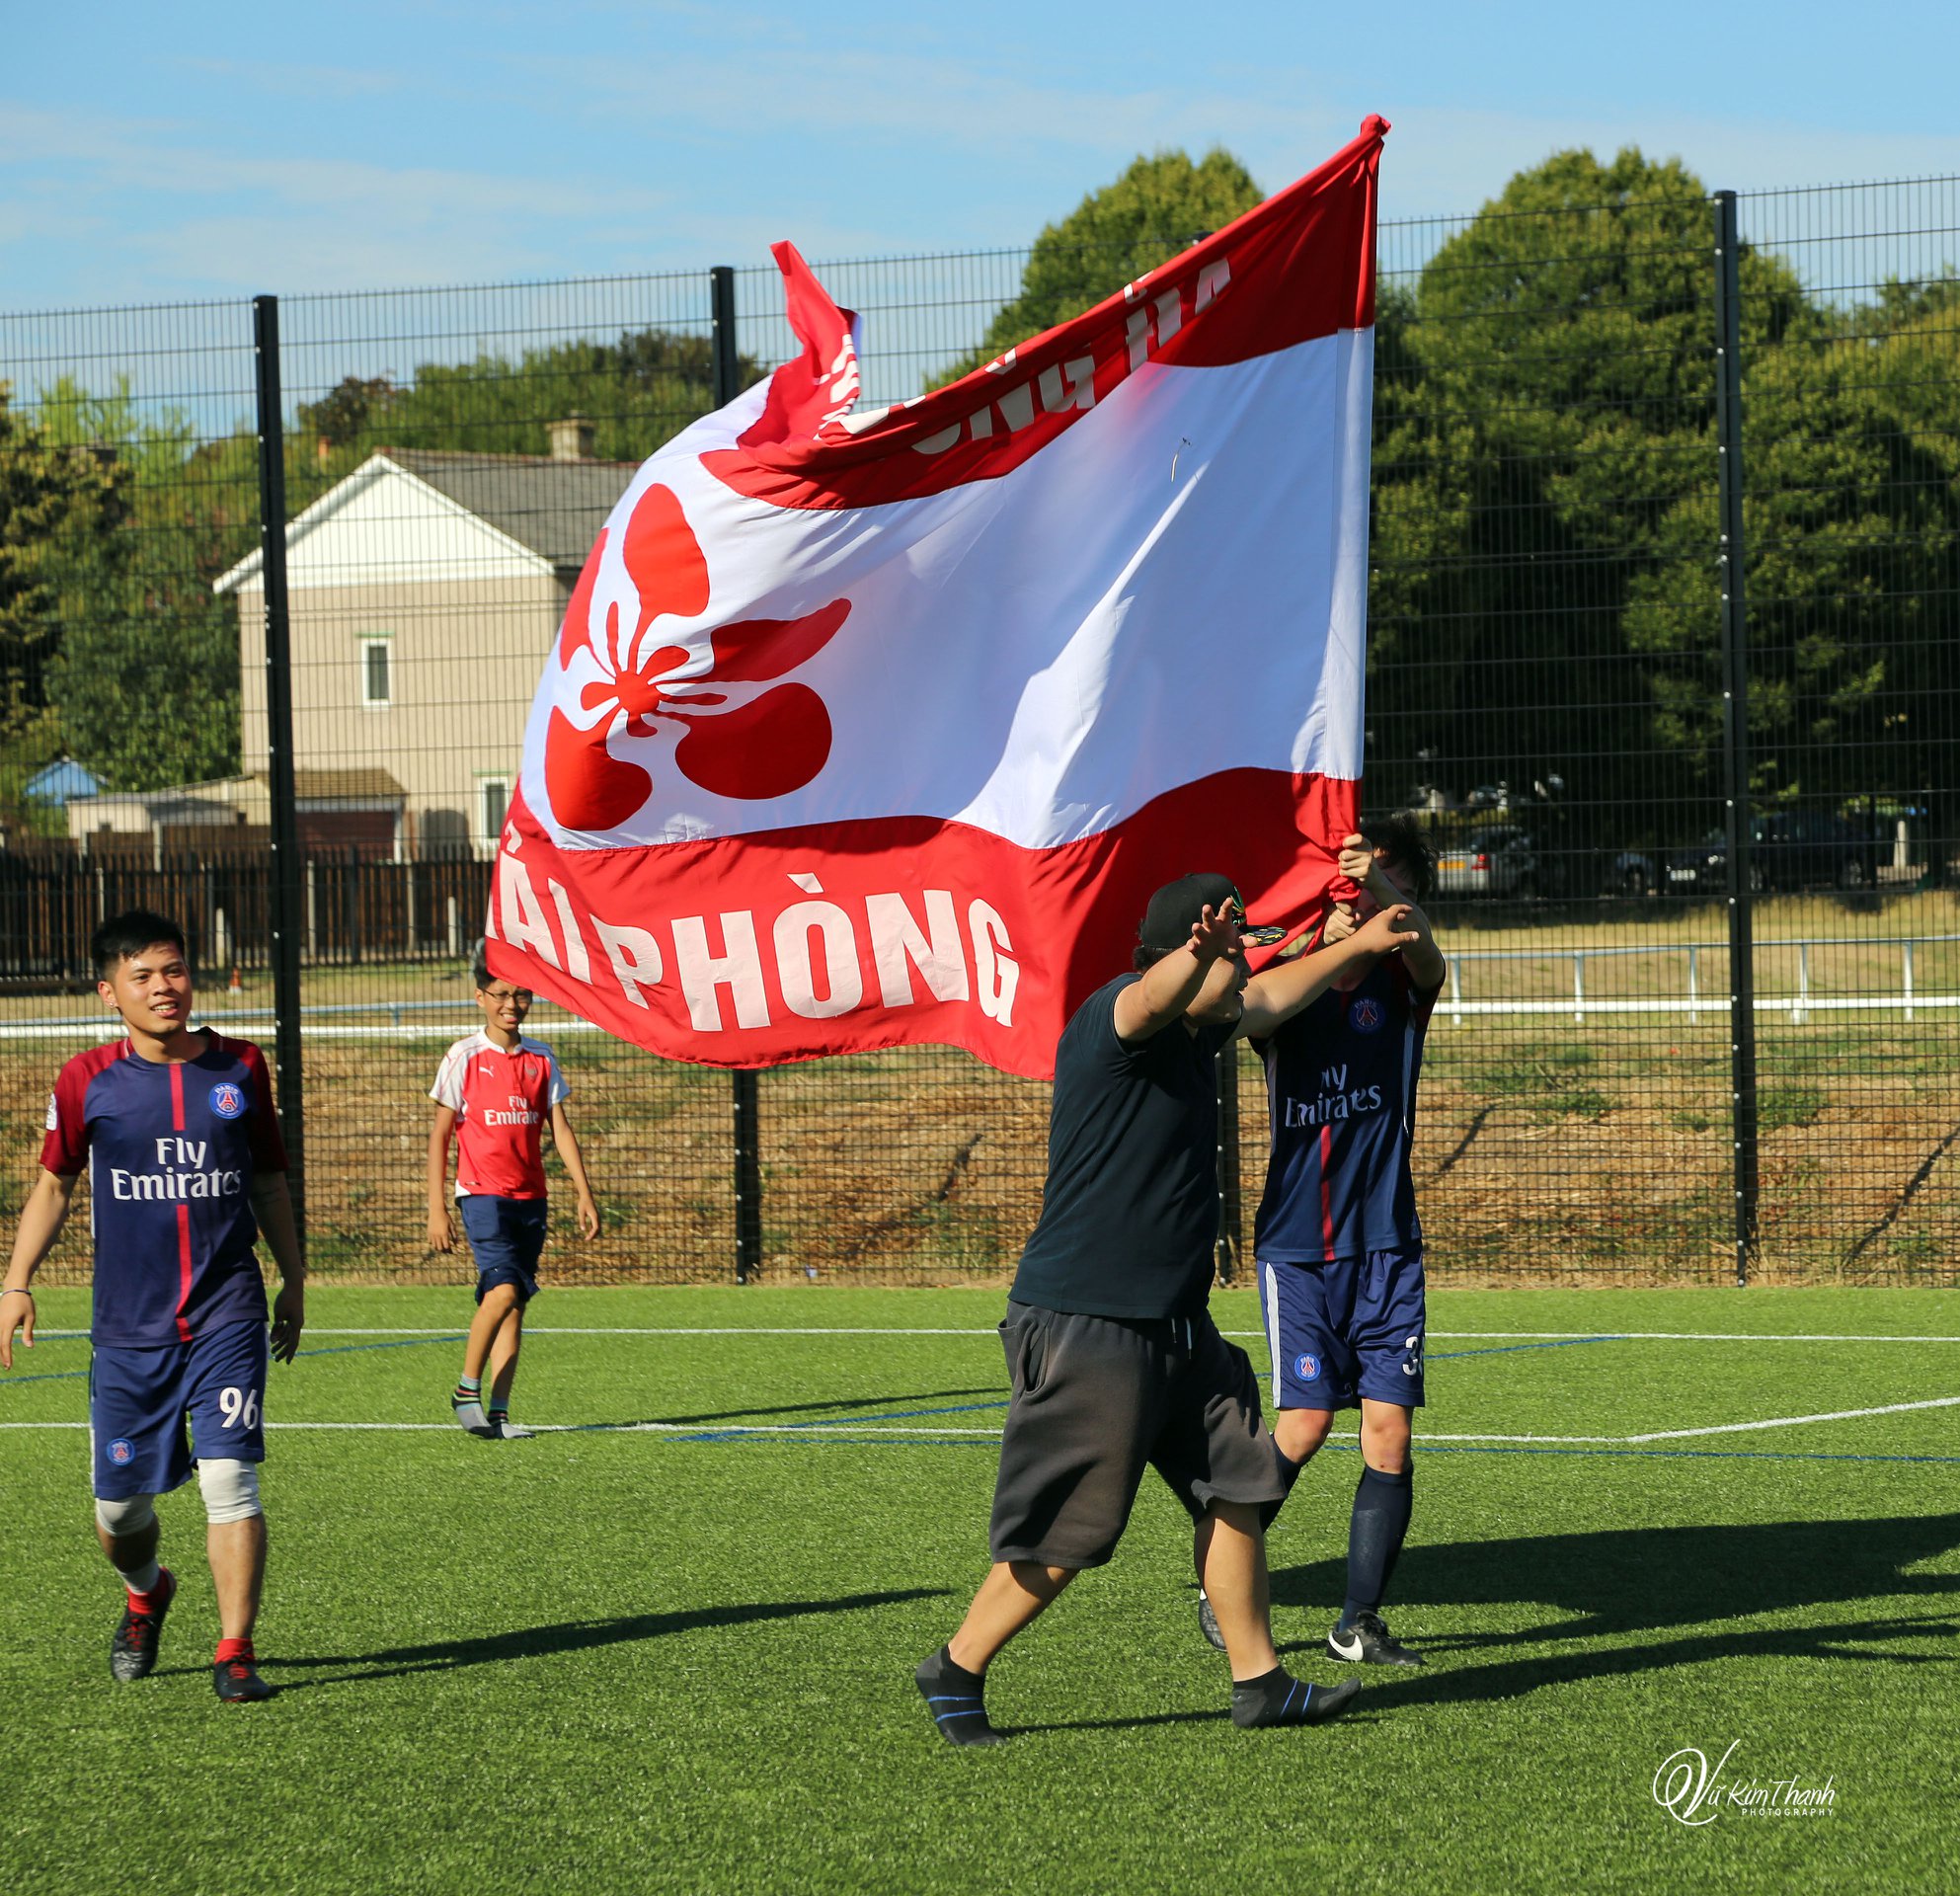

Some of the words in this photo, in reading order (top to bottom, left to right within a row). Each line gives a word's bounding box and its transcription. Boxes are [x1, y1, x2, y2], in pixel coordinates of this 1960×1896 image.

[485, 819, 593, 986] ẢI
[588, 871, 1020, 1033] PHÒNG
[508, 1095, 528, 1110] Fly
[155, 1137, 207, 1169] Fly
[110, 1166, 242, 1201] Emirates
[219, 1386, 259, 1430] 96
